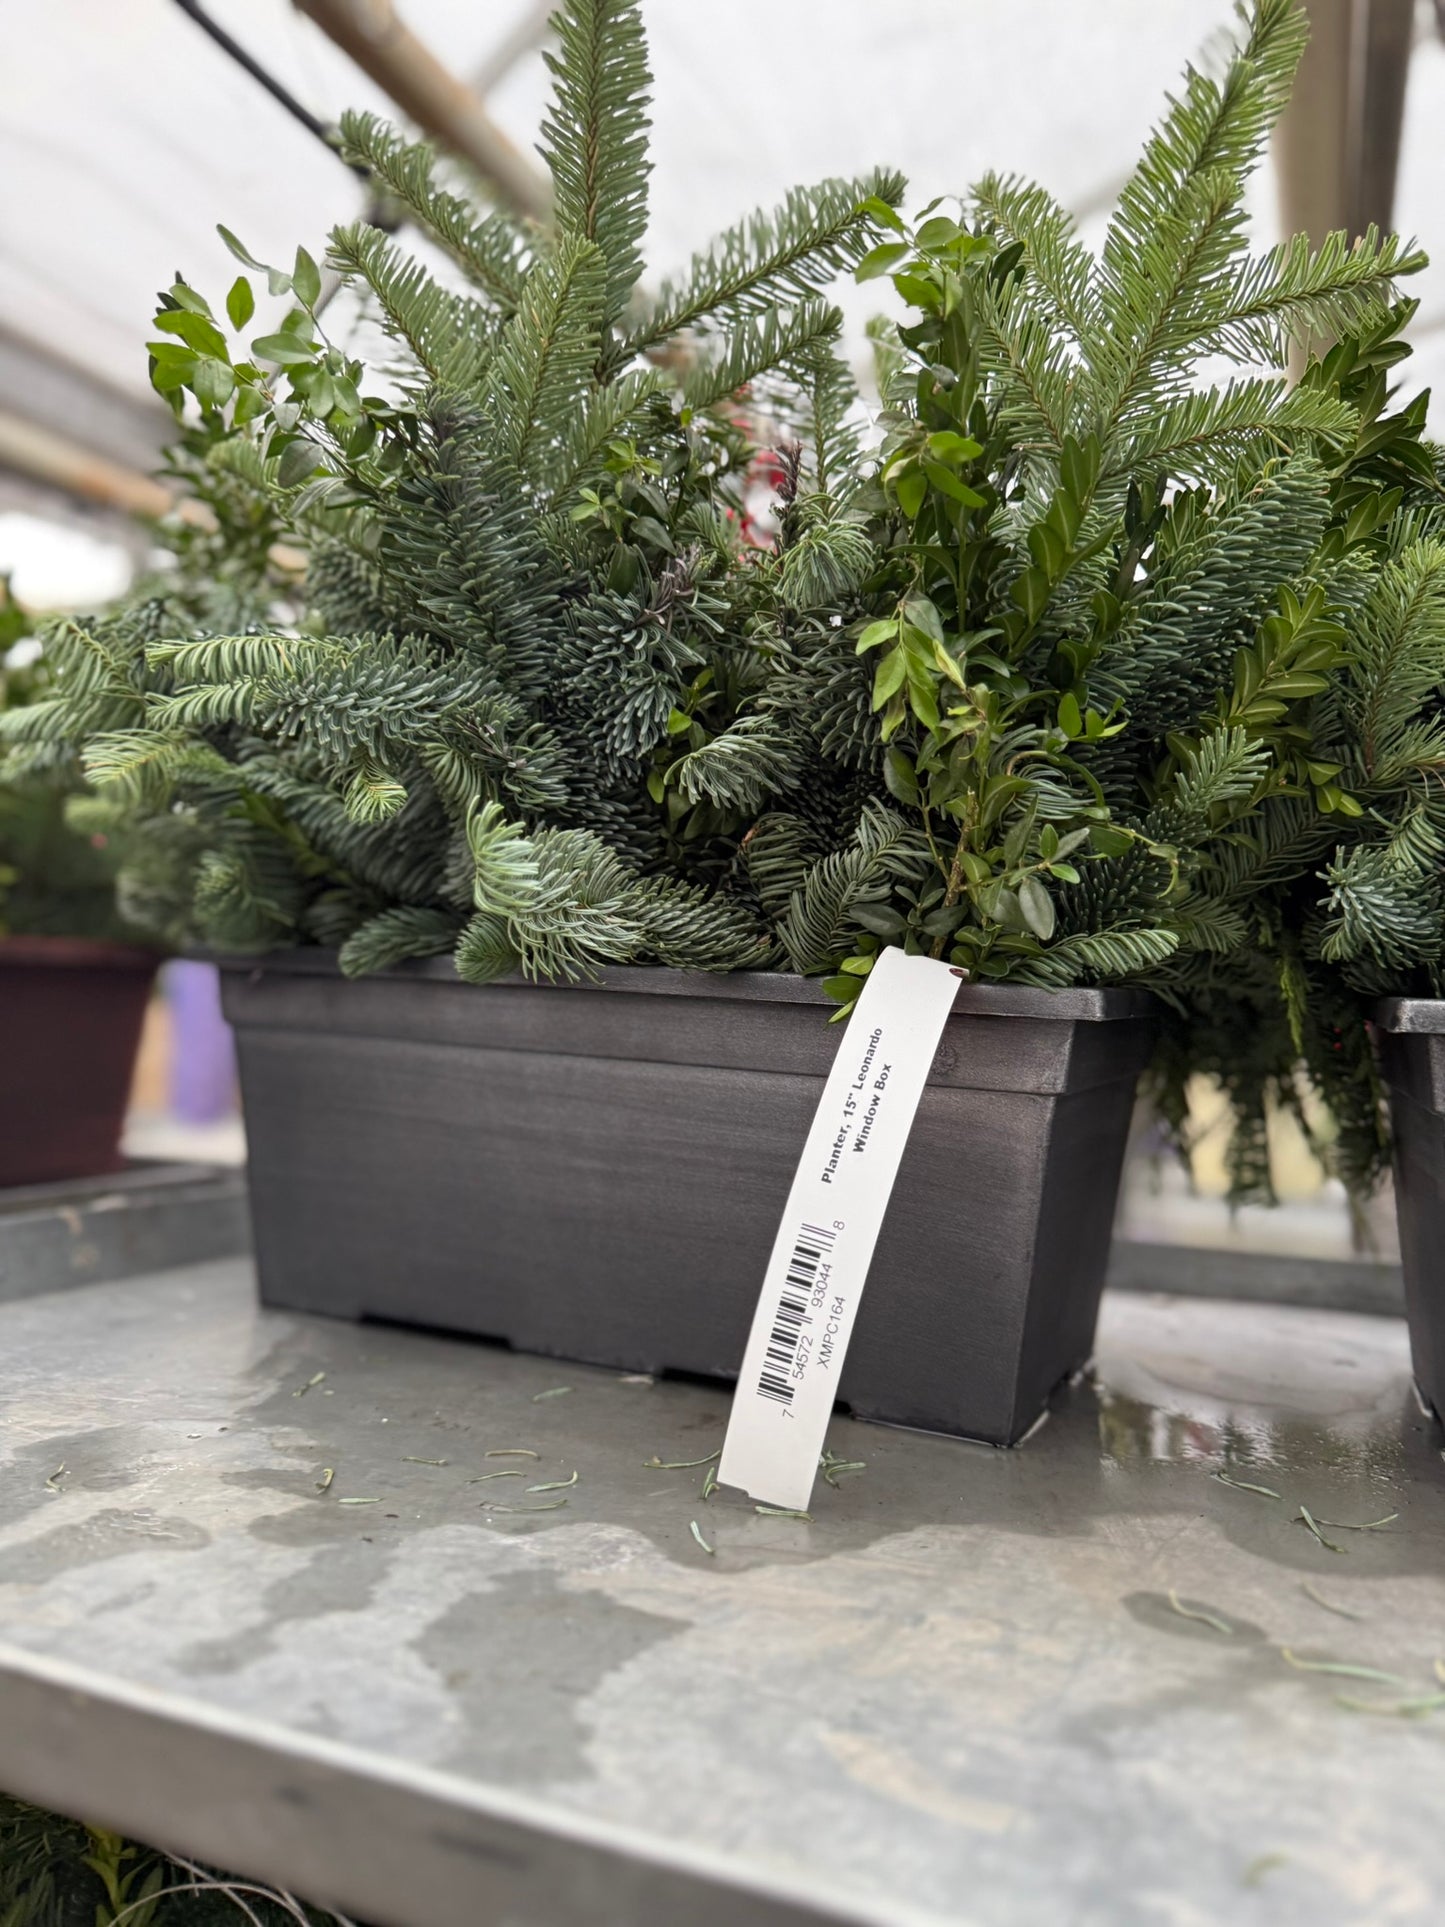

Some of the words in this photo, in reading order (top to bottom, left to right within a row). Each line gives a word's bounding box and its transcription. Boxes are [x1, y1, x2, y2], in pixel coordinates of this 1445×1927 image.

[821, 1124, 852, 1184] Planter,
[843, 1092, 857, 1118] 15"
[852, 1028, 883, 1090] Leonardo
[852, 1094, 881, 1153] Window
[874, 1063, 892, 1091] Box
[782, 1408, 794, 1419] 7
[792, 1335, 814, 1380] 54572
[811, 1263, 833, 1308] 93044
[833, 1220, 845, 1231] 8
[816, 1296, 846, 1369] XMPC164
